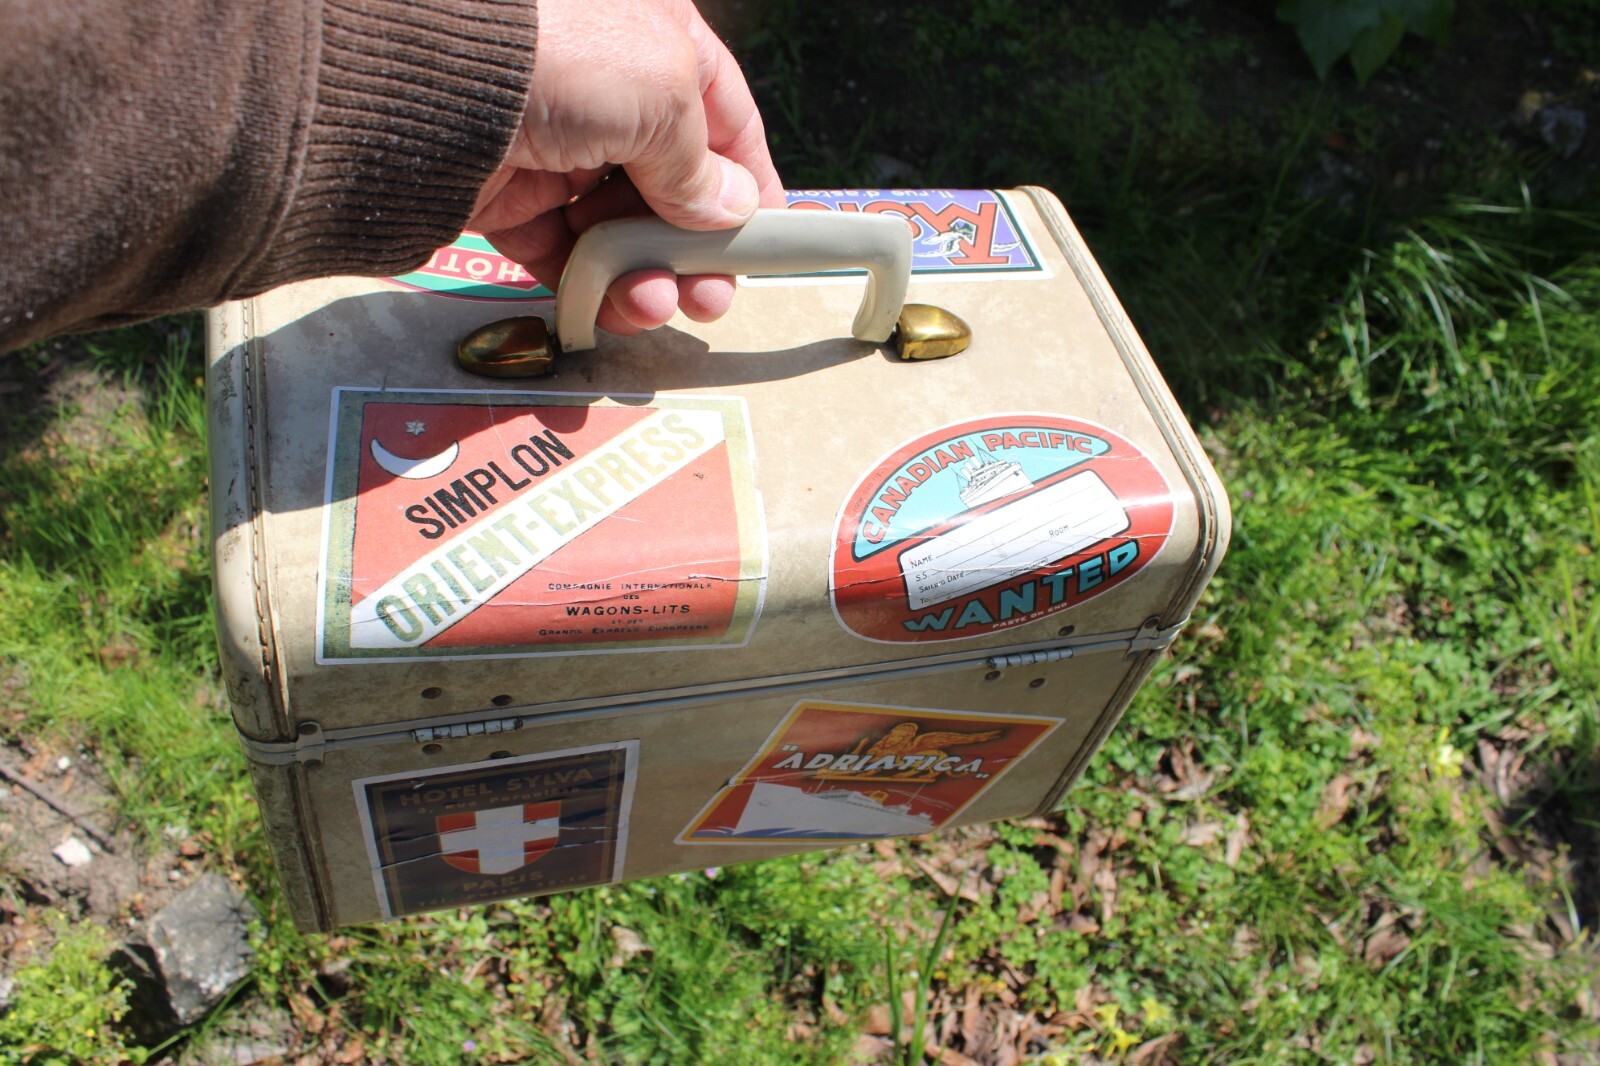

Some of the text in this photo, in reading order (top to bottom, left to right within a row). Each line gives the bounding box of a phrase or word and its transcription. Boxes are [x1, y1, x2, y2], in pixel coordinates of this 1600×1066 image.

[426, 249, 526, 282] HÔT
[405, 429, 576, 540] SIMPLON
[863, 440, 978, 544] CANADIAN
[982, 431, 1092, 455] PACIFIC
[374, 412, 705, 643] ORIENT-EXPRESS
[1049, 524, 1070, 539] ROOM
[910, 554, 933, 569] NAME
[548, 583, 612, 591] COMPAGNIE
[904, 539, 1139, 632] WANTED
[947, 571, 964, 583] DATE
[566, 604, 692, 617] WAGONS-LITS
[992, 616, 1027, 629] PASTE
[1048, 602, 1068, 612] END
[400, 768, 593, 807] HOTEL SYLVA
[463, 871, 544, 892] PARIS
